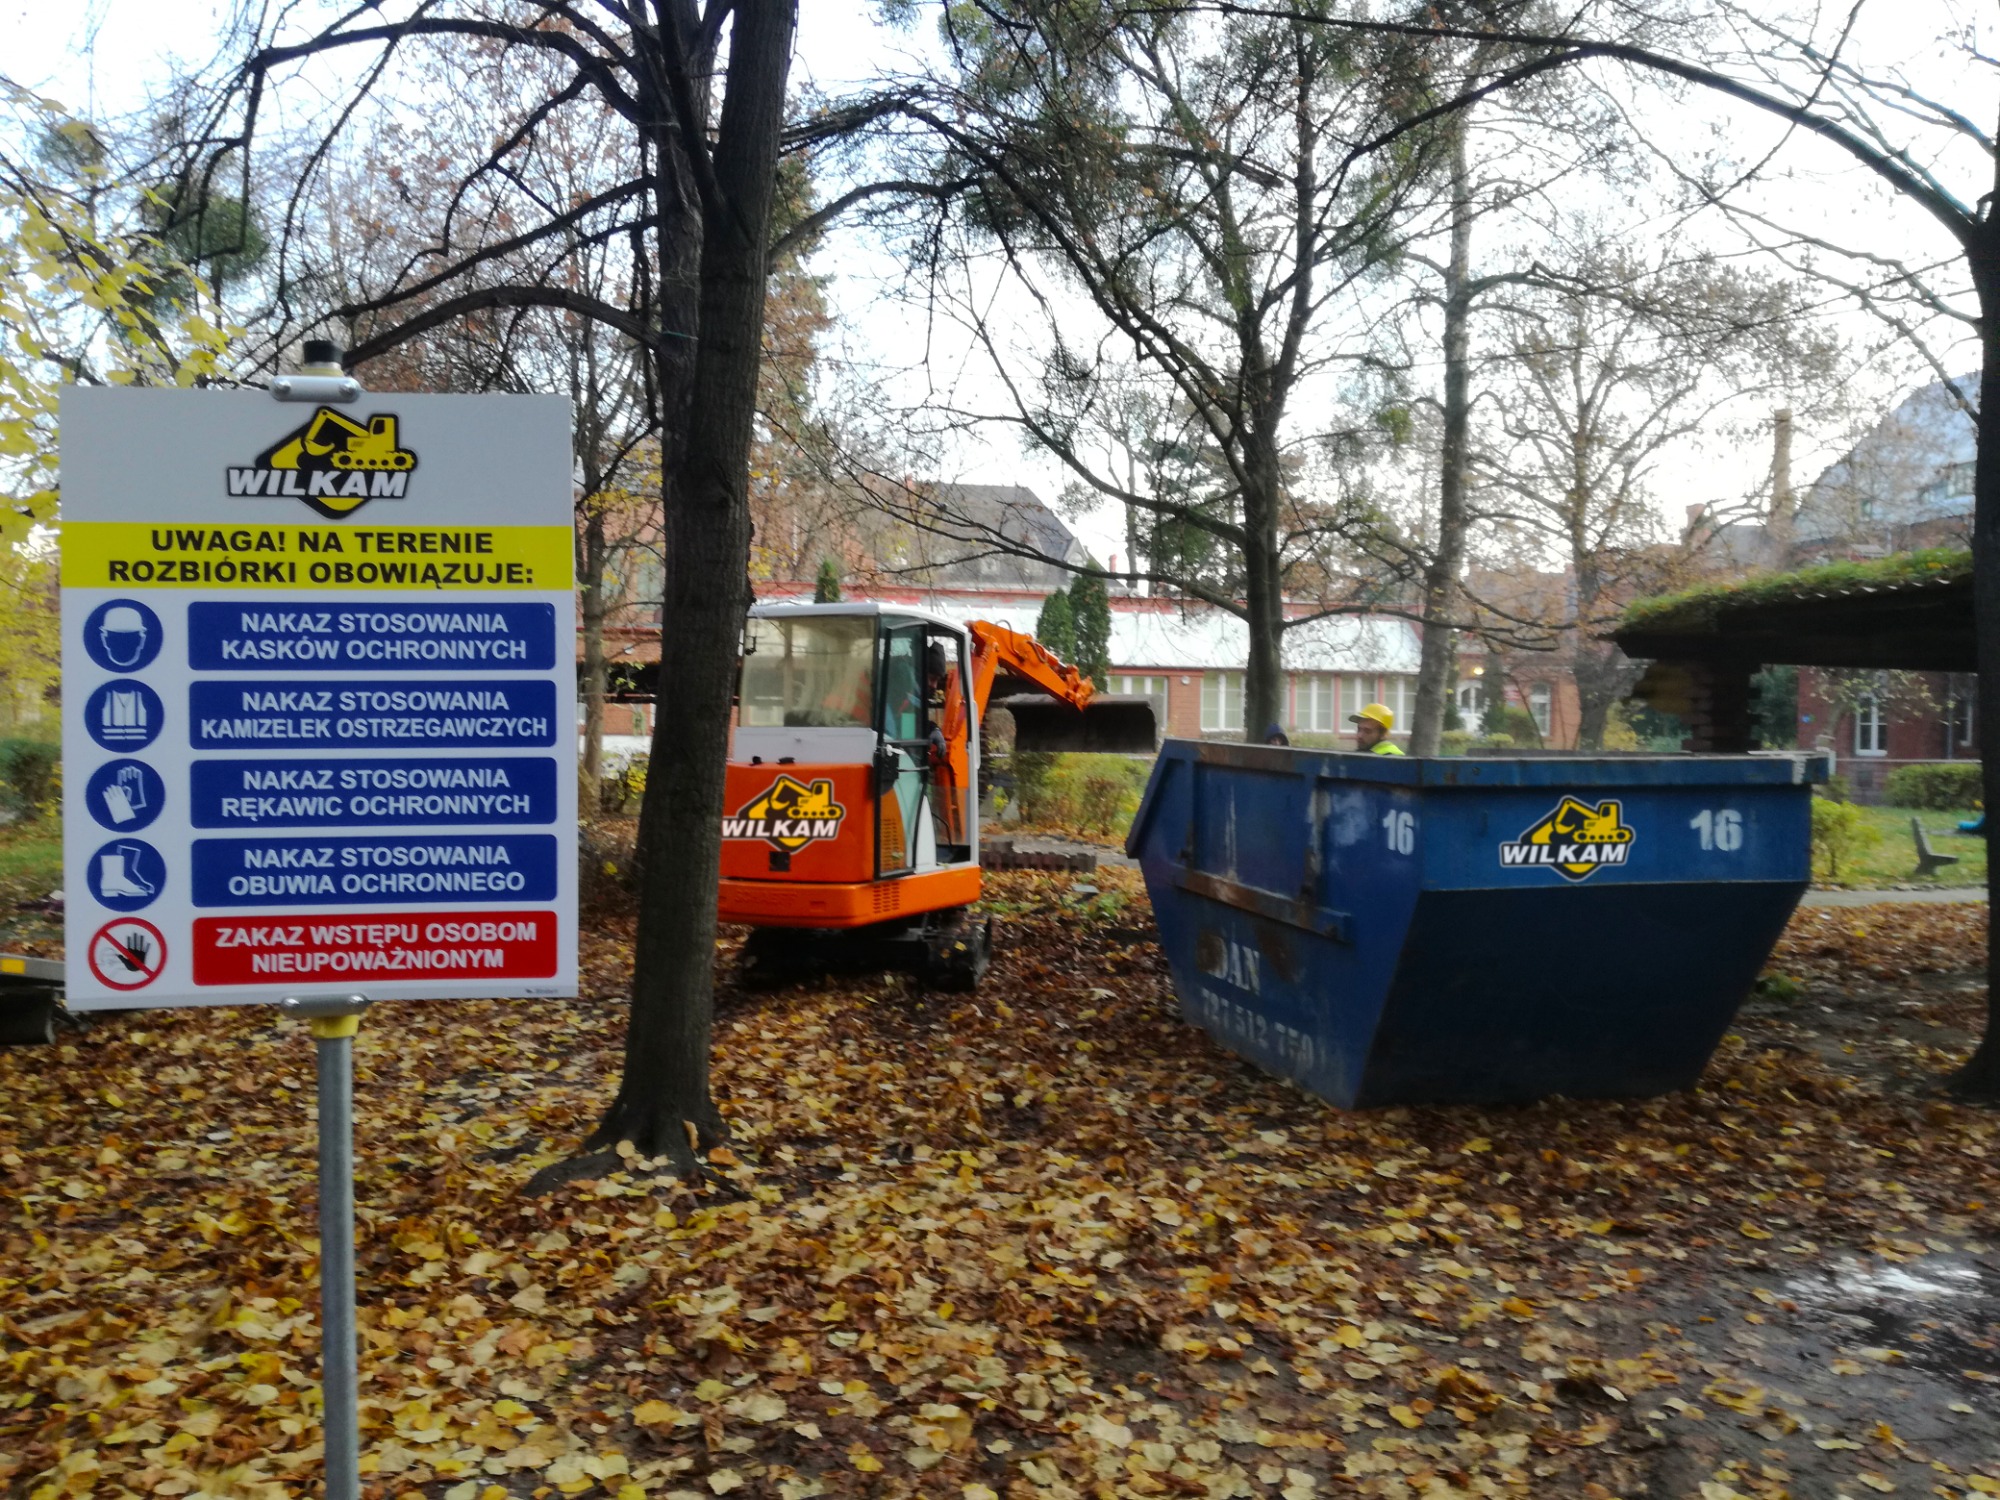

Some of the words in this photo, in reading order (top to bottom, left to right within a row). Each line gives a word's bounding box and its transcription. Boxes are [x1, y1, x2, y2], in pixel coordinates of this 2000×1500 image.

[229, 469, 408, 497] WILKAM
[152, 530, 286, 552] UWAGA!
[299, 532, 343, 552] NA
[355, 533, 493, 554] TERENIE
[109, 556, 296, 583] ROZBIÓRKI
[309, 563, 533, 589] OBOWIĄZUJE:
[241, 613, 332, 633] NAKAZ
[339, 613, 508, 633] STOSOWANIA
[222, 635, 340, 659] KASKÓW
[345, 640, 527, 659] OCHRONNYCH
[242, 691, 332, 712] NAKAZ
[339, 691, 509, 711] STOSOWANIA
[201, 719, 331, 739] KAMIZELEK
[337, 717, 547, 738] OSTRZEGAWCZYCH
[243, 770, 334, 790] NAKAZ
[340, 768, 509, 789] STOSOWANIA
[222, 797, 342, 822] RĘKAWIC
[349, 794, 529, 816] OCHRONNYCH
[722, 819, 837, 837] WILKAM
[1382, 809, 1415, 855] 16
[1690, 809, 1743, 851] 16
[244, 848, 334, 869] NAKAZ
[341, 846, 510, 867] STOSOWANIA
[1503, 843, 1627, 864] WILKAM
[228, 874, 335, 896] OBUWIA
[341, 872, 525, 894] OCHRONNEGO
[215, 926, 304, 948] ZAKAZ
[310, 924, 418, 948] WSTĘPU
[425, 922, 537, 943] OSOBOM
[253, 947, 504, 973] NIEUPOWAŻNIONYM
